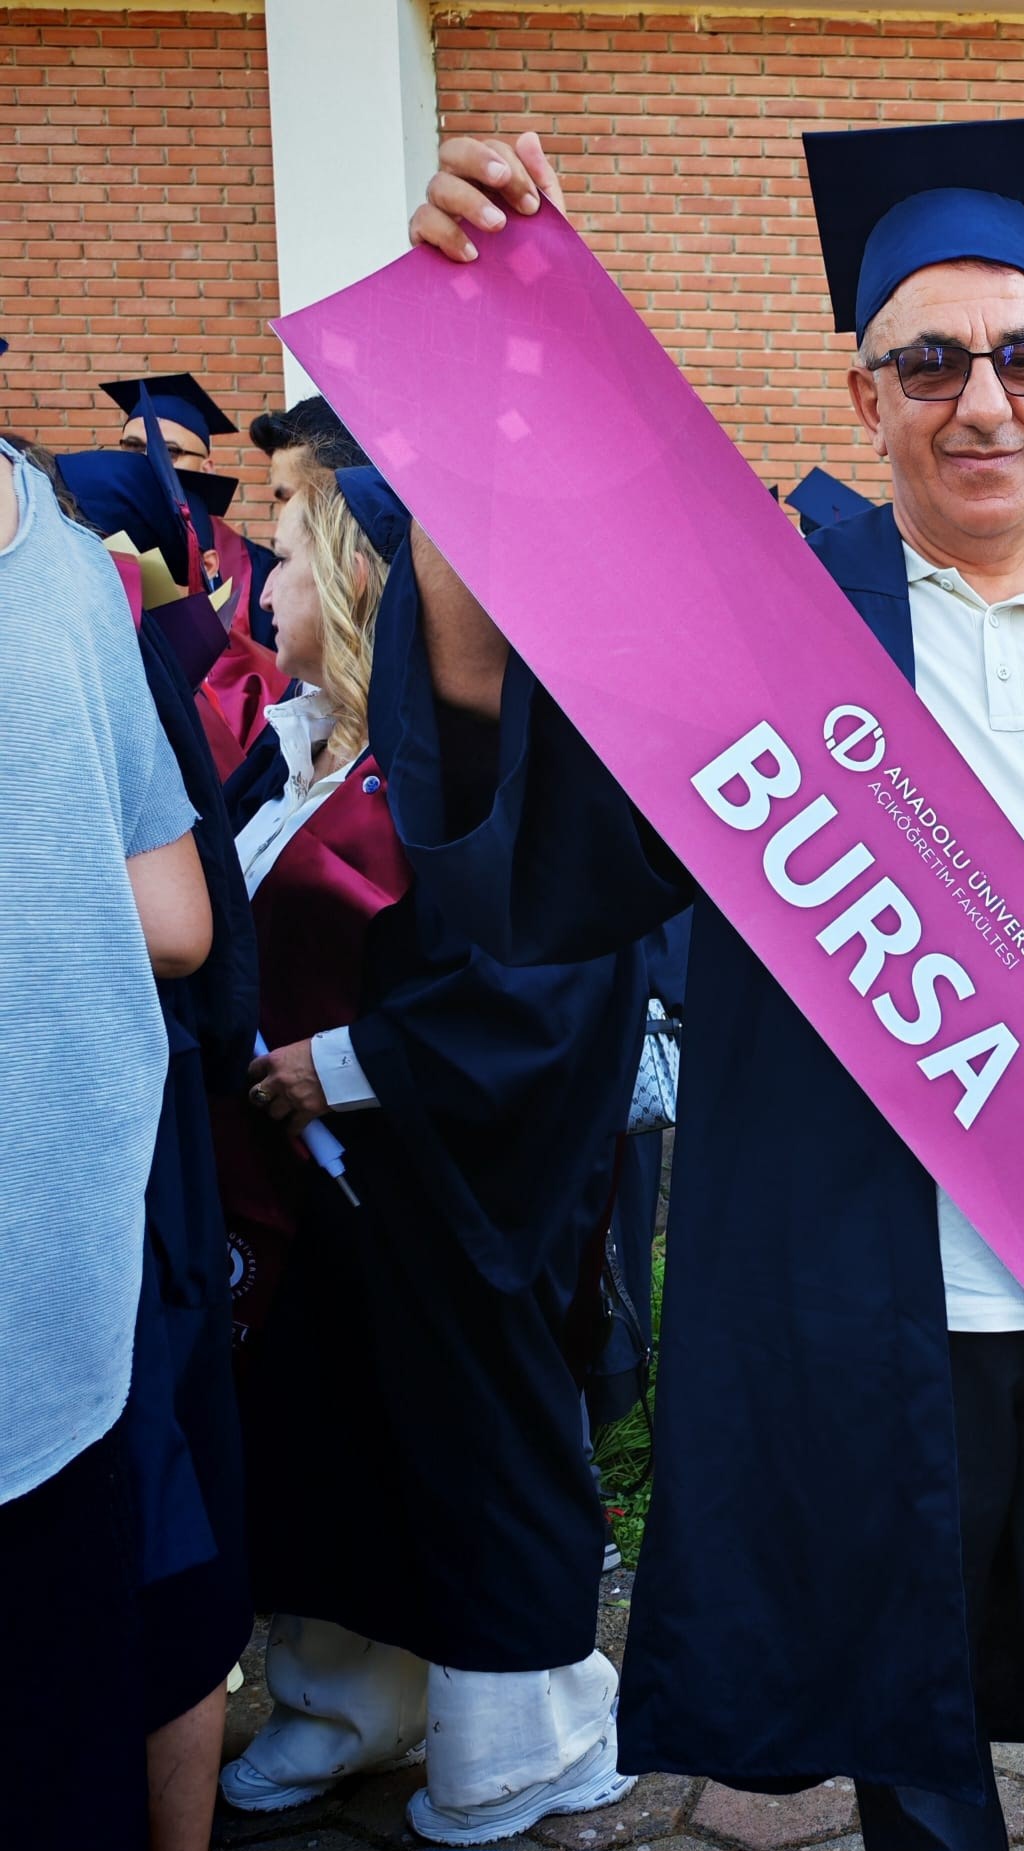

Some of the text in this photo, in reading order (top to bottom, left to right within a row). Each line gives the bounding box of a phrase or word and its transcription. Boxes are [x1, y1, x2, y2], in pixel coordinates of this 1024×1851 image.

[867, 780, 1019, 970] AÇIKÖĞRETİM FAKÜLTESİ
[884, 766, 972, 870] ANADOLU
[690, 720, 1021, 1131] BURSA
